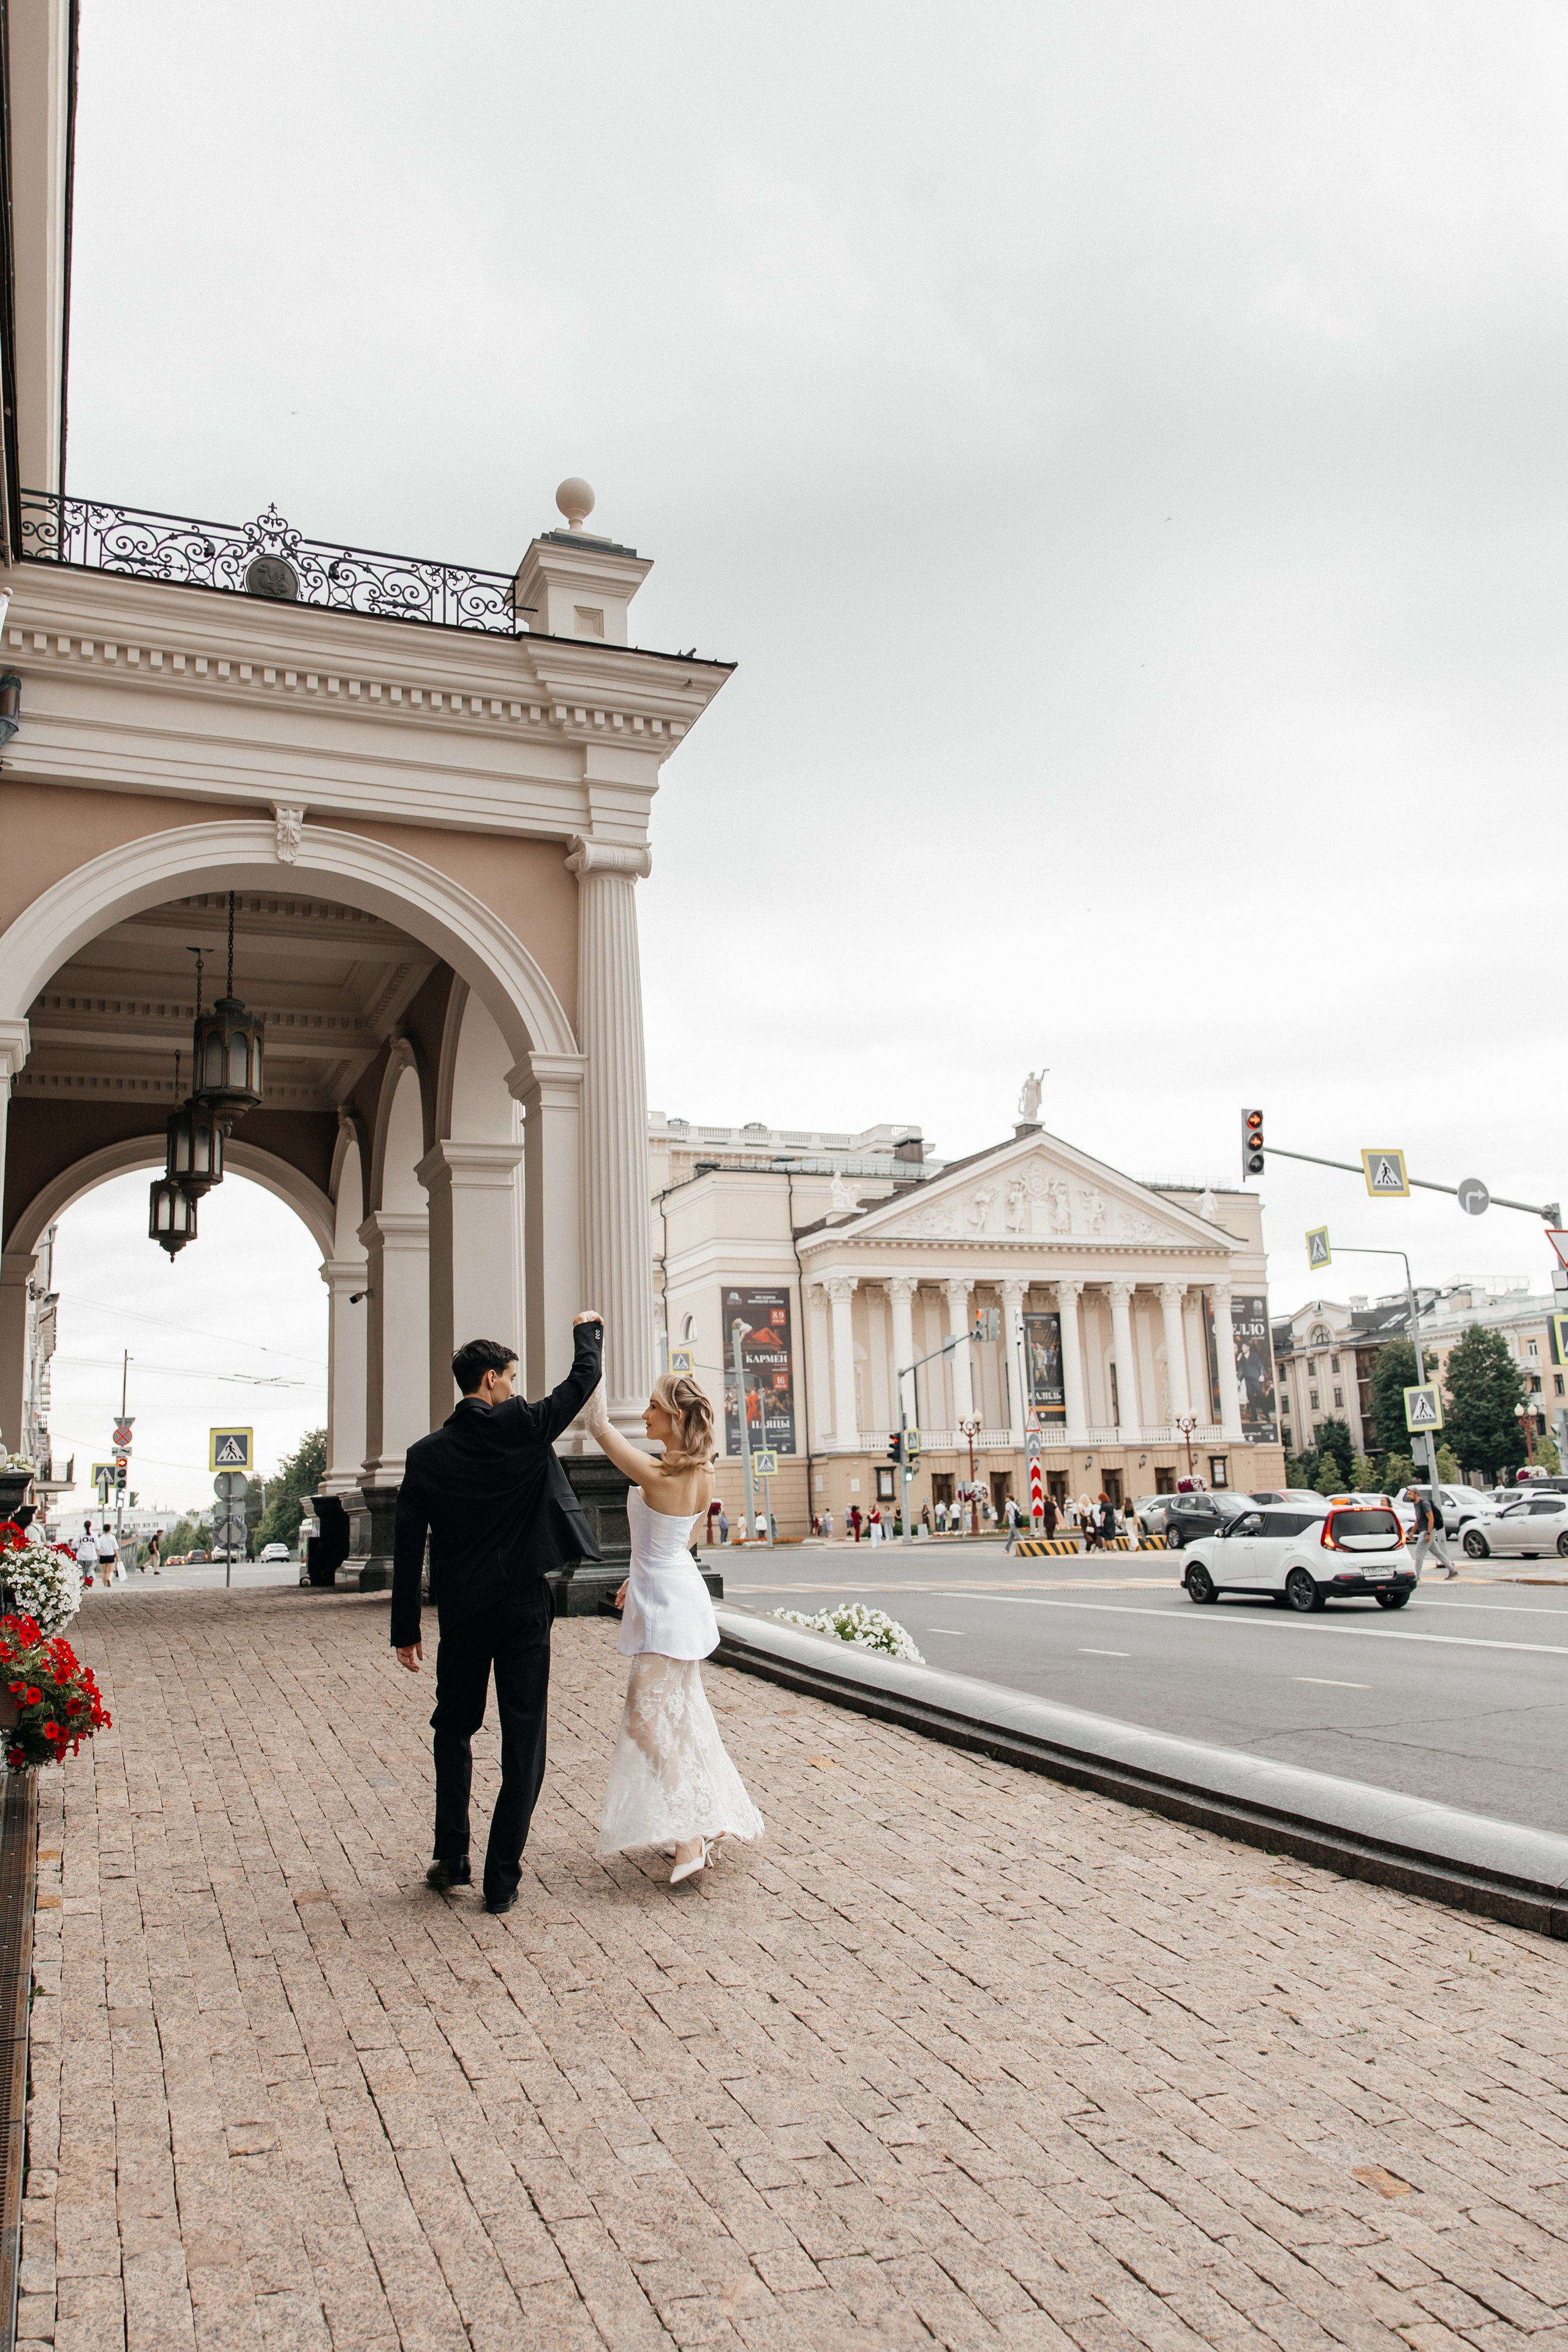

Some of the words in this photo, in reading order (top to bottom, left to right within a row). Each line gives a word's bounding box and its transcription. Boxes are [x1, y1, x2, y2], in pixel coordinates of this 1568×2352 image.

[1212, 1323, 1265, 1336] ЕЛЛО
[745, 1354, 788, 1363] КАРМЕН
[776, 1376, 786, 1384] 16
